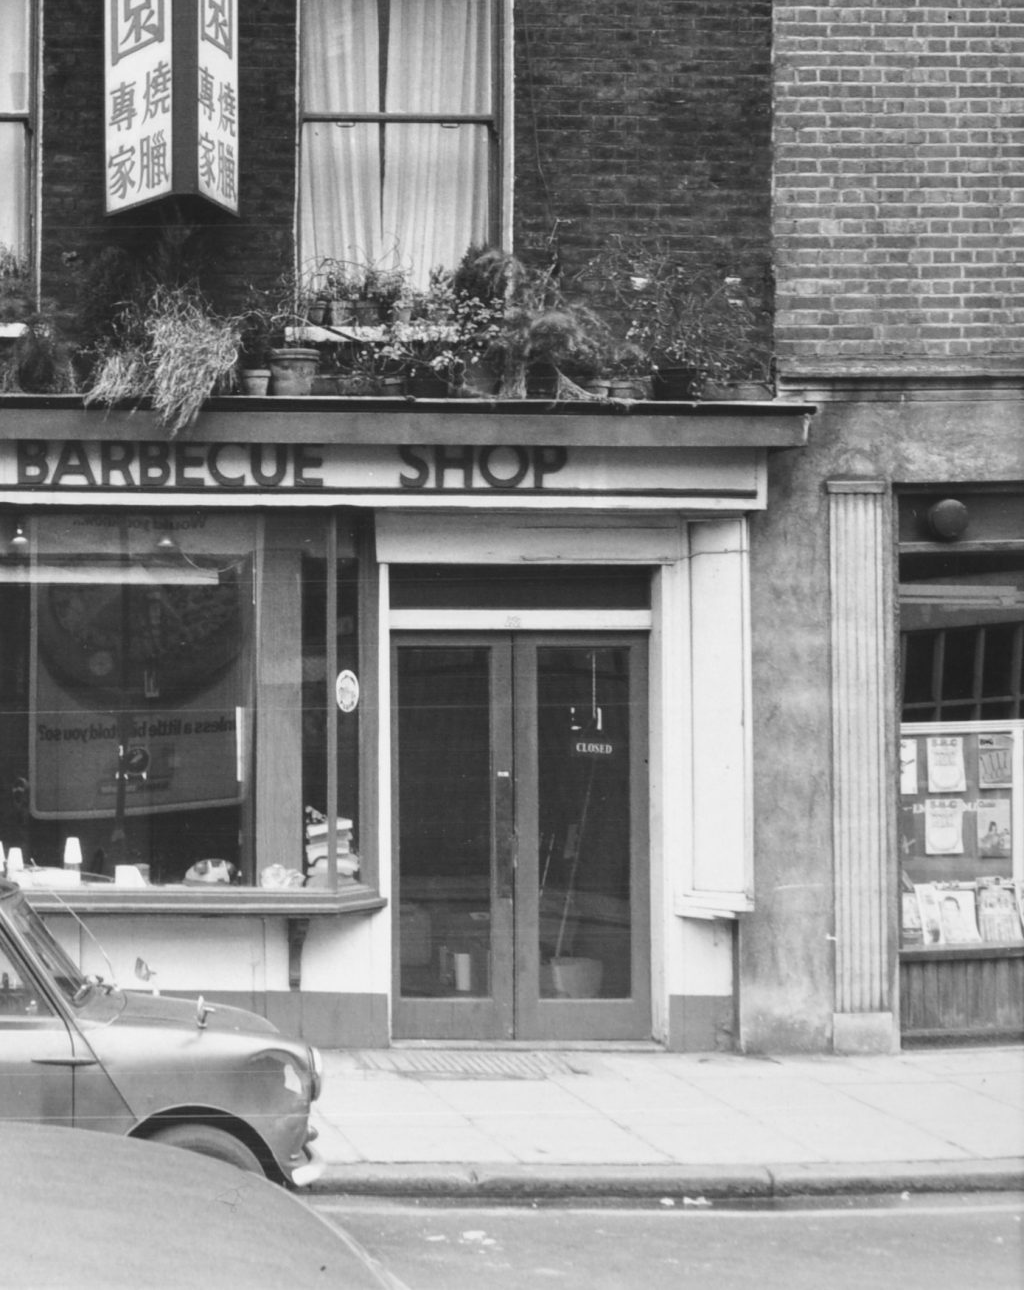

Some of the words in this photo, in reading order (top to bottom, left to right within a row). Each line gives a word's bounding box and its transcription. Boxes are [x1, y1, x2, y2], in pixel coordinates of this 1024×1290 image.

[17, 439, 324, 487] BARBECUE
[399, 444, 568, 489] SHOP
[575, 742, 613, 755] CLOSED
